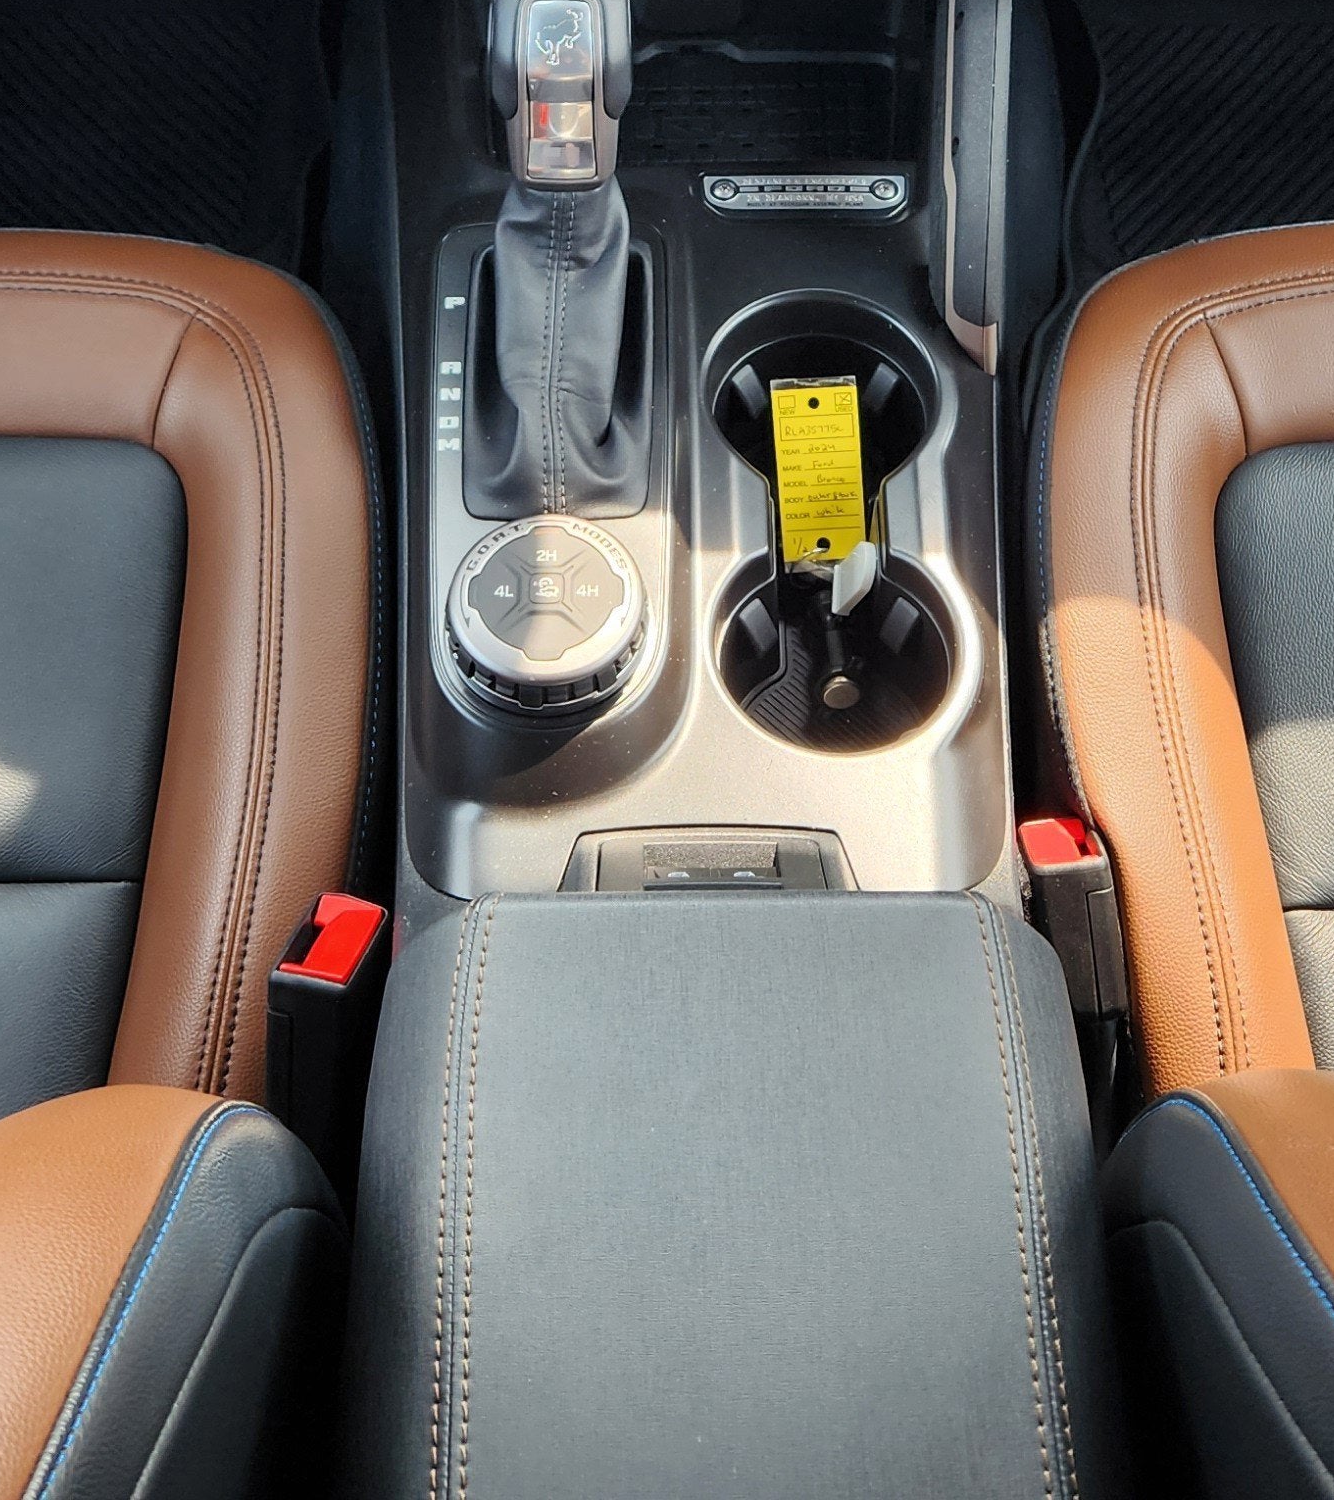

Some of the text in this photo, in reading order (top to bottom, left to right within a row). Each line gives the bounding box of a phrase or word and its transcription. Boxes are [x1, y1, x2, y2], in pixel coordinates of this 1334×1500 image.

[444, 296, 466, 310] P
[439, 387, 461, 401] N
[438, 416, 460, 429] D
[437, 438, 461, 451] M
[572, 522, 628, 570] MODES
[536, 550, 558, 562] 2H
[494, 585, 514, 598] 4L
[575, 585, 599, 597] 4H
